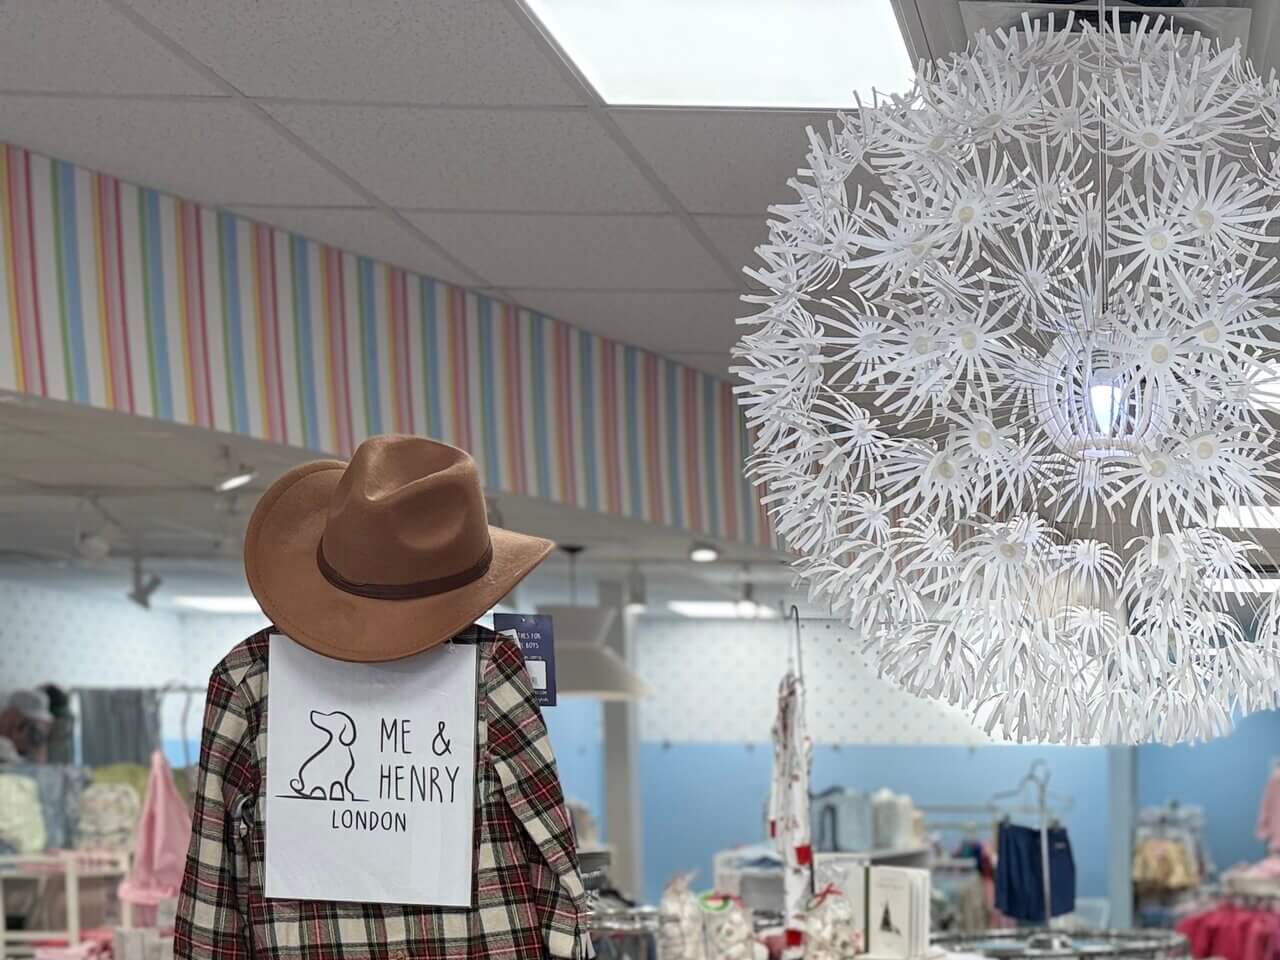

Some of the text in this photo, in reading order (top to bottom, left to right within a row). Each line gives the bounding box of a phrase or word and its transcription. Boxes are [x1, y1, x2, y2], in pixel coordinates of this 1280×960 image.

[380, 717, 452, 756] ME &
[379, 764, 460, 803] HENRY
[332, 809, 407, 832] LONDON
